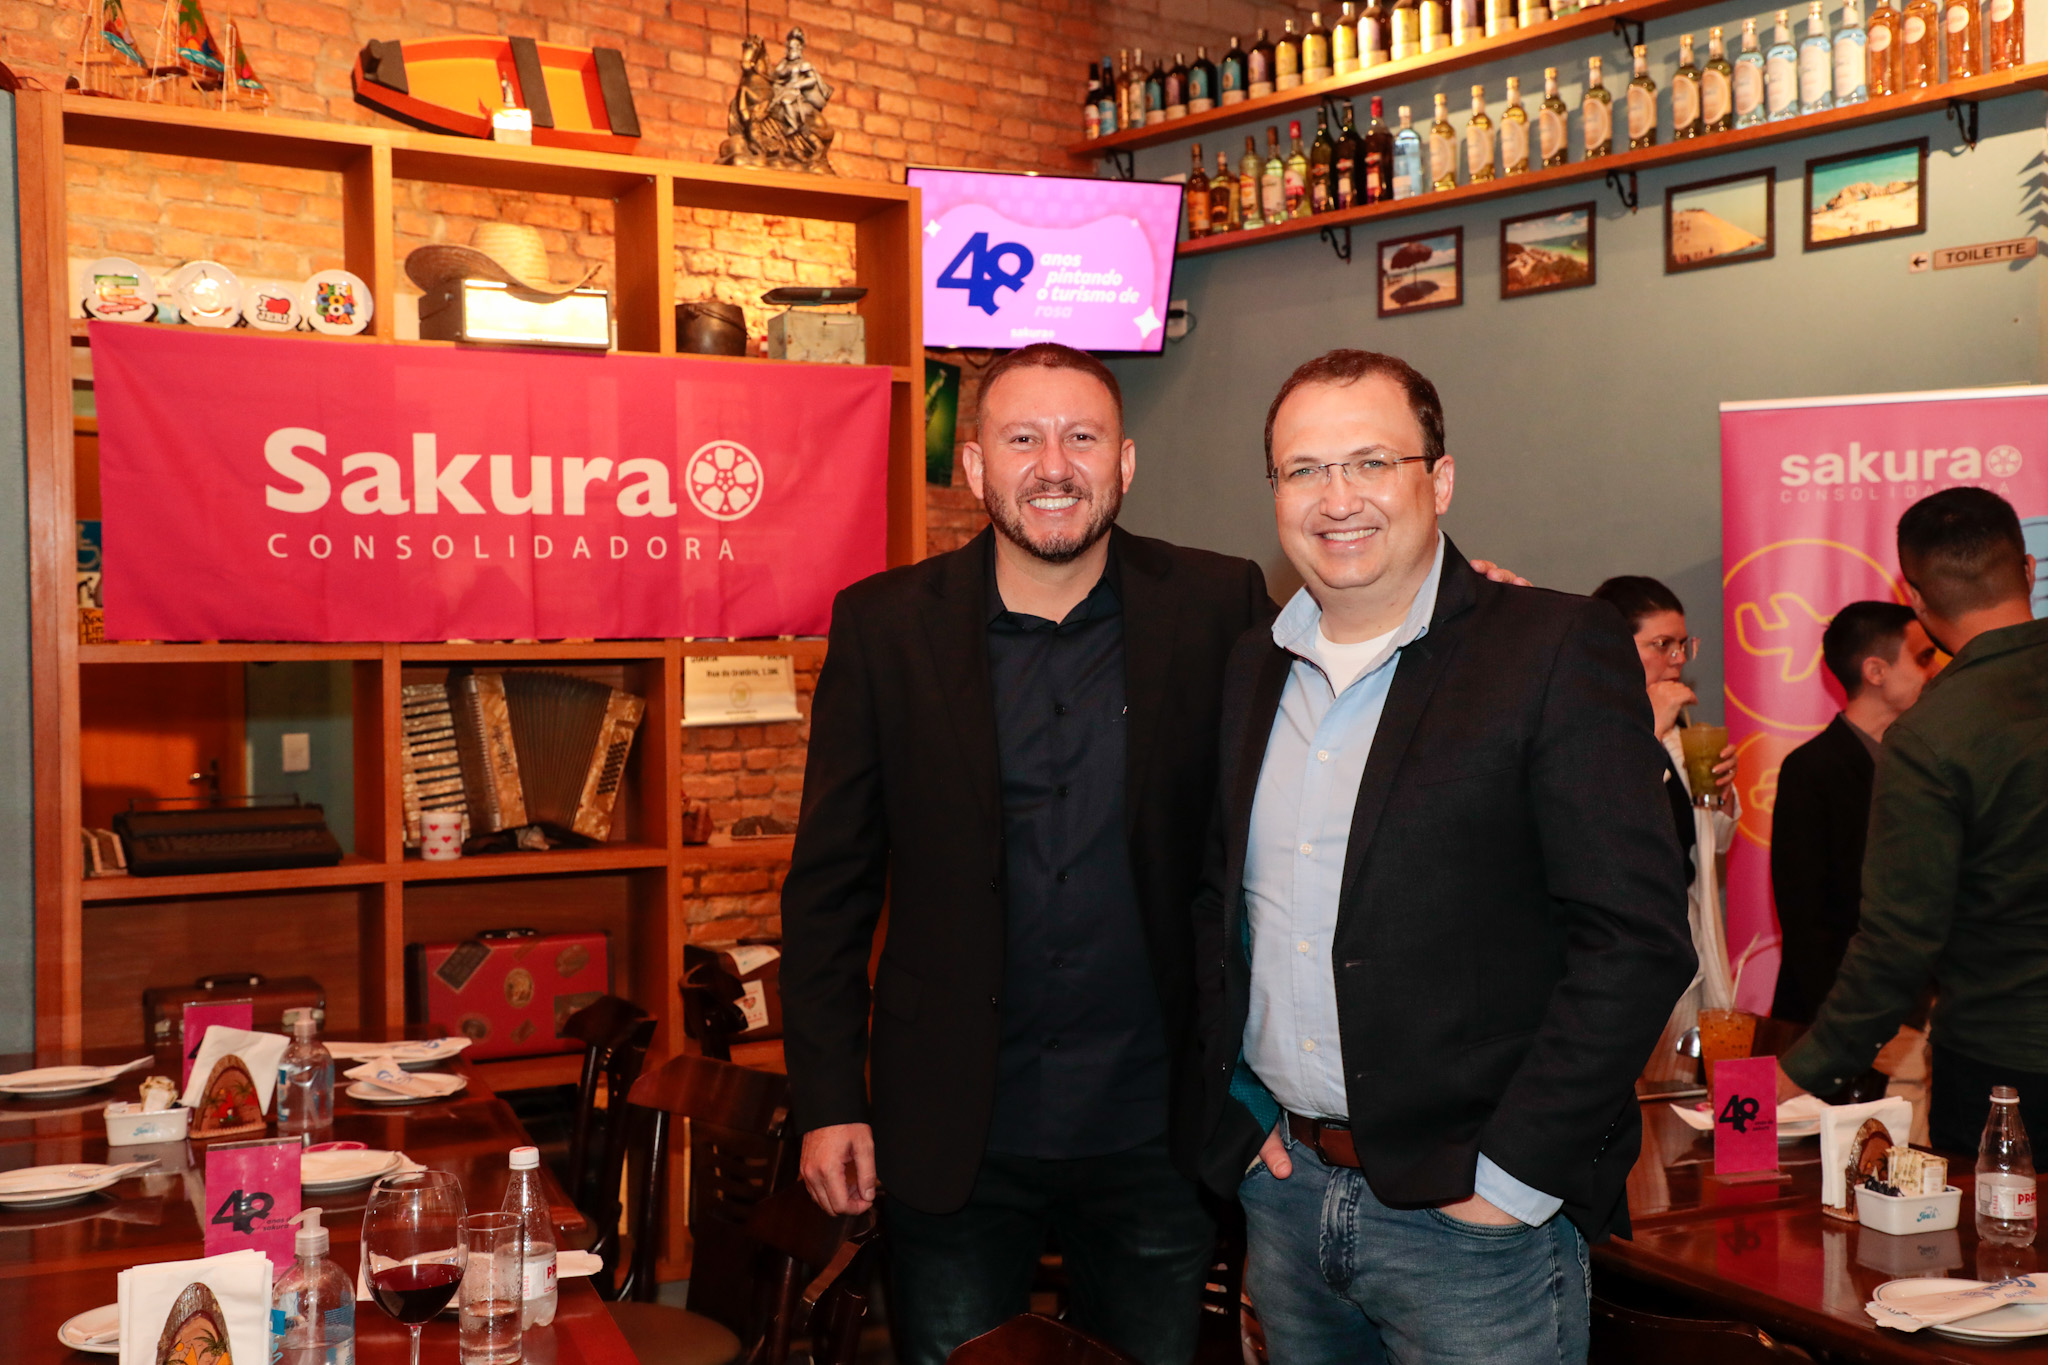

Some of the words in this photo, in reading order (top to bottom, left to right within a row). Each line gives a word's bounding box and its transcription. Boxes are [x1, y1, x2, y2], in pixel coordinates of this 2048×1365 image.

[1040, 253, 1082, 266] anos
[1946, 242, 2026, 263] TOILETTE
[1045, 268, 1123, 286] pintando
[1036, 287, 1047, 300] o
[1051, 286, 1116, 303] turismo
[1118, 286, 1140, 304] de
[1035, 304, 1073, 318] rosa
[264, 427, 678, 518] Sakura
[1780, 442, 1982, 487] sakura
[1780, 480, 2010, 504] CONSOLIDAA
[267, 533, 735, 561] CONSOLIDADORA
